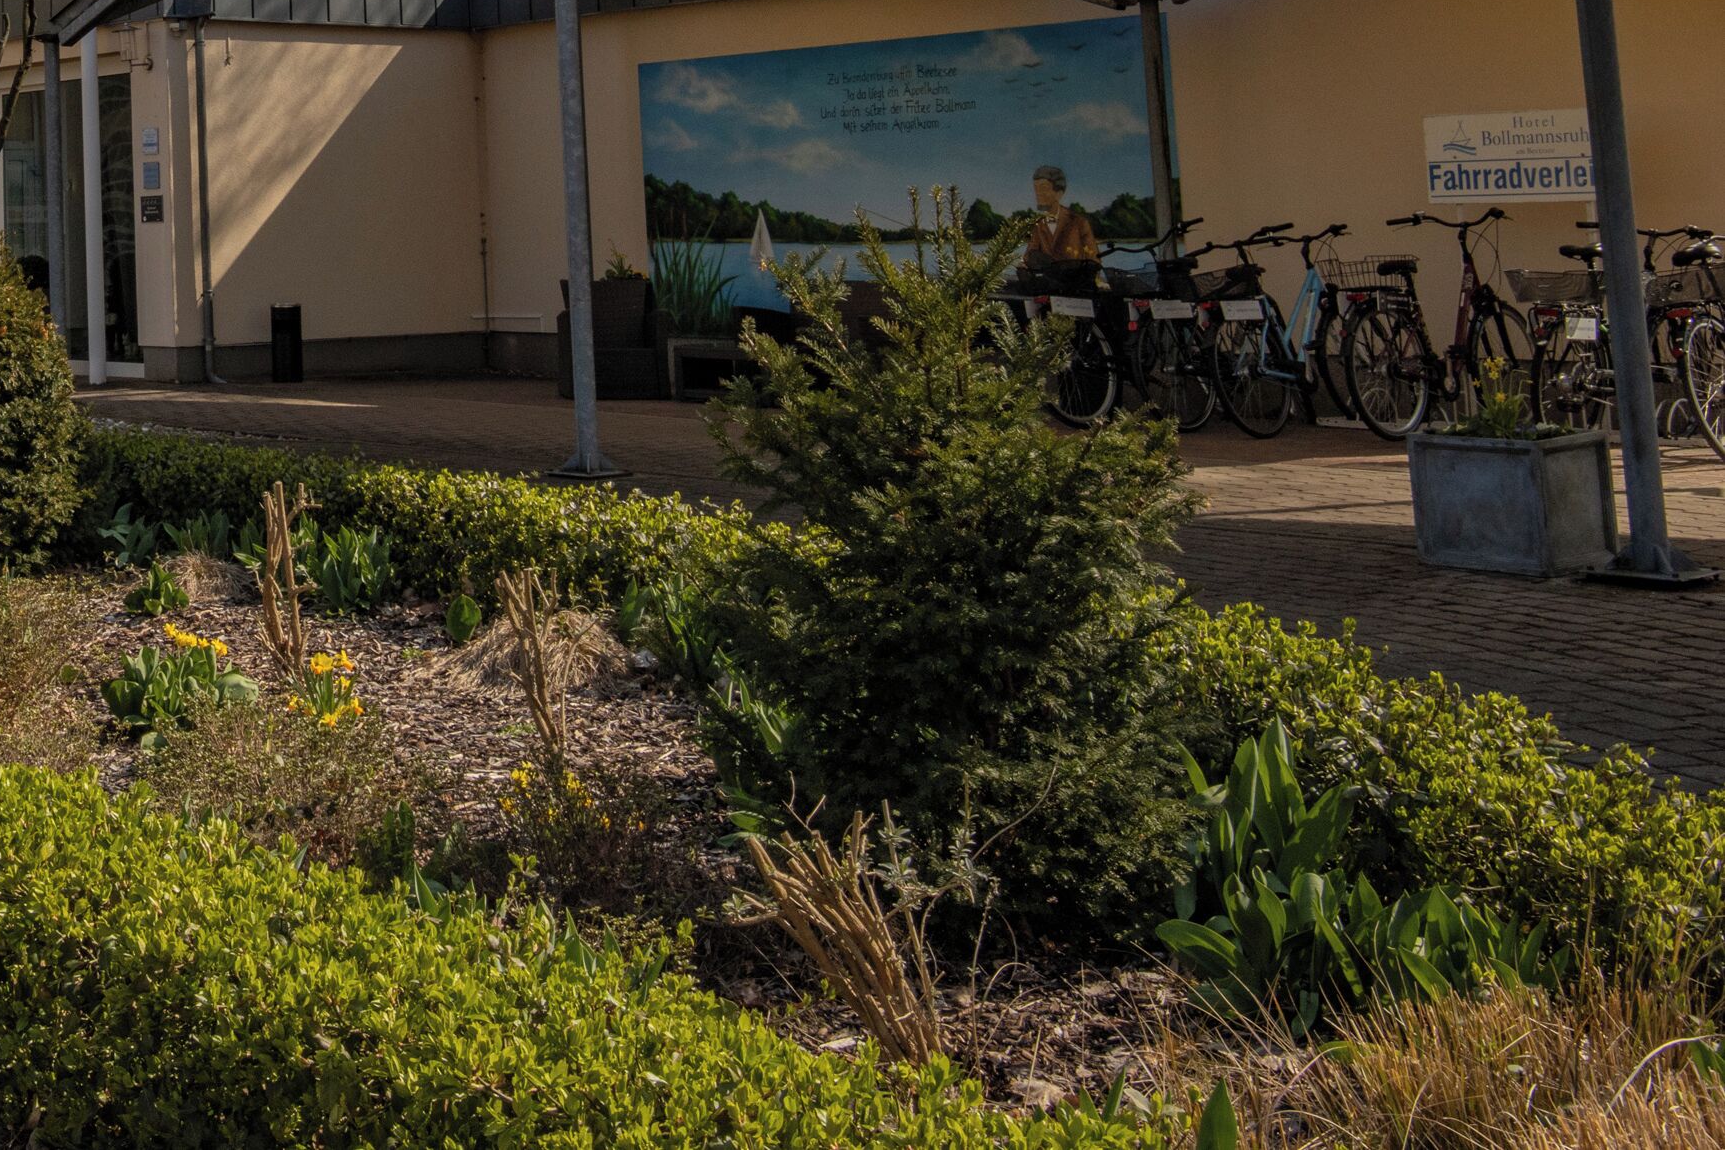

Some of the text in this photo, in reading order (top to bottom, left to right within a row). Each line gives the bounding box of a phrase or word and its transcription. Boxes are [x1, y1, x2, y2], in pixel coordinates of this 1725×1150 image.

[827, 73, 840, 85] Zu
[856, 88, 867, 100] da
[868, 86, 885, 102] liegt
[887, 85, 900, 98] ein
[820, 106, 836, 119] Und
[840, 104, 860, 118] darin
[890, 102, 904, 115] der
[904, 99, 931, 114] Fritze
[935, 97, 977, 113] Bollmann
[843, 120, 857, 134] Mit
[859, 119, 888, 132] seinem
[1512, 114, 1556, 129] Hotel
[1481, 126, 1591, 147] Bollmannsruh
[1428, 159, 1596, 191] Fahrradverlei
